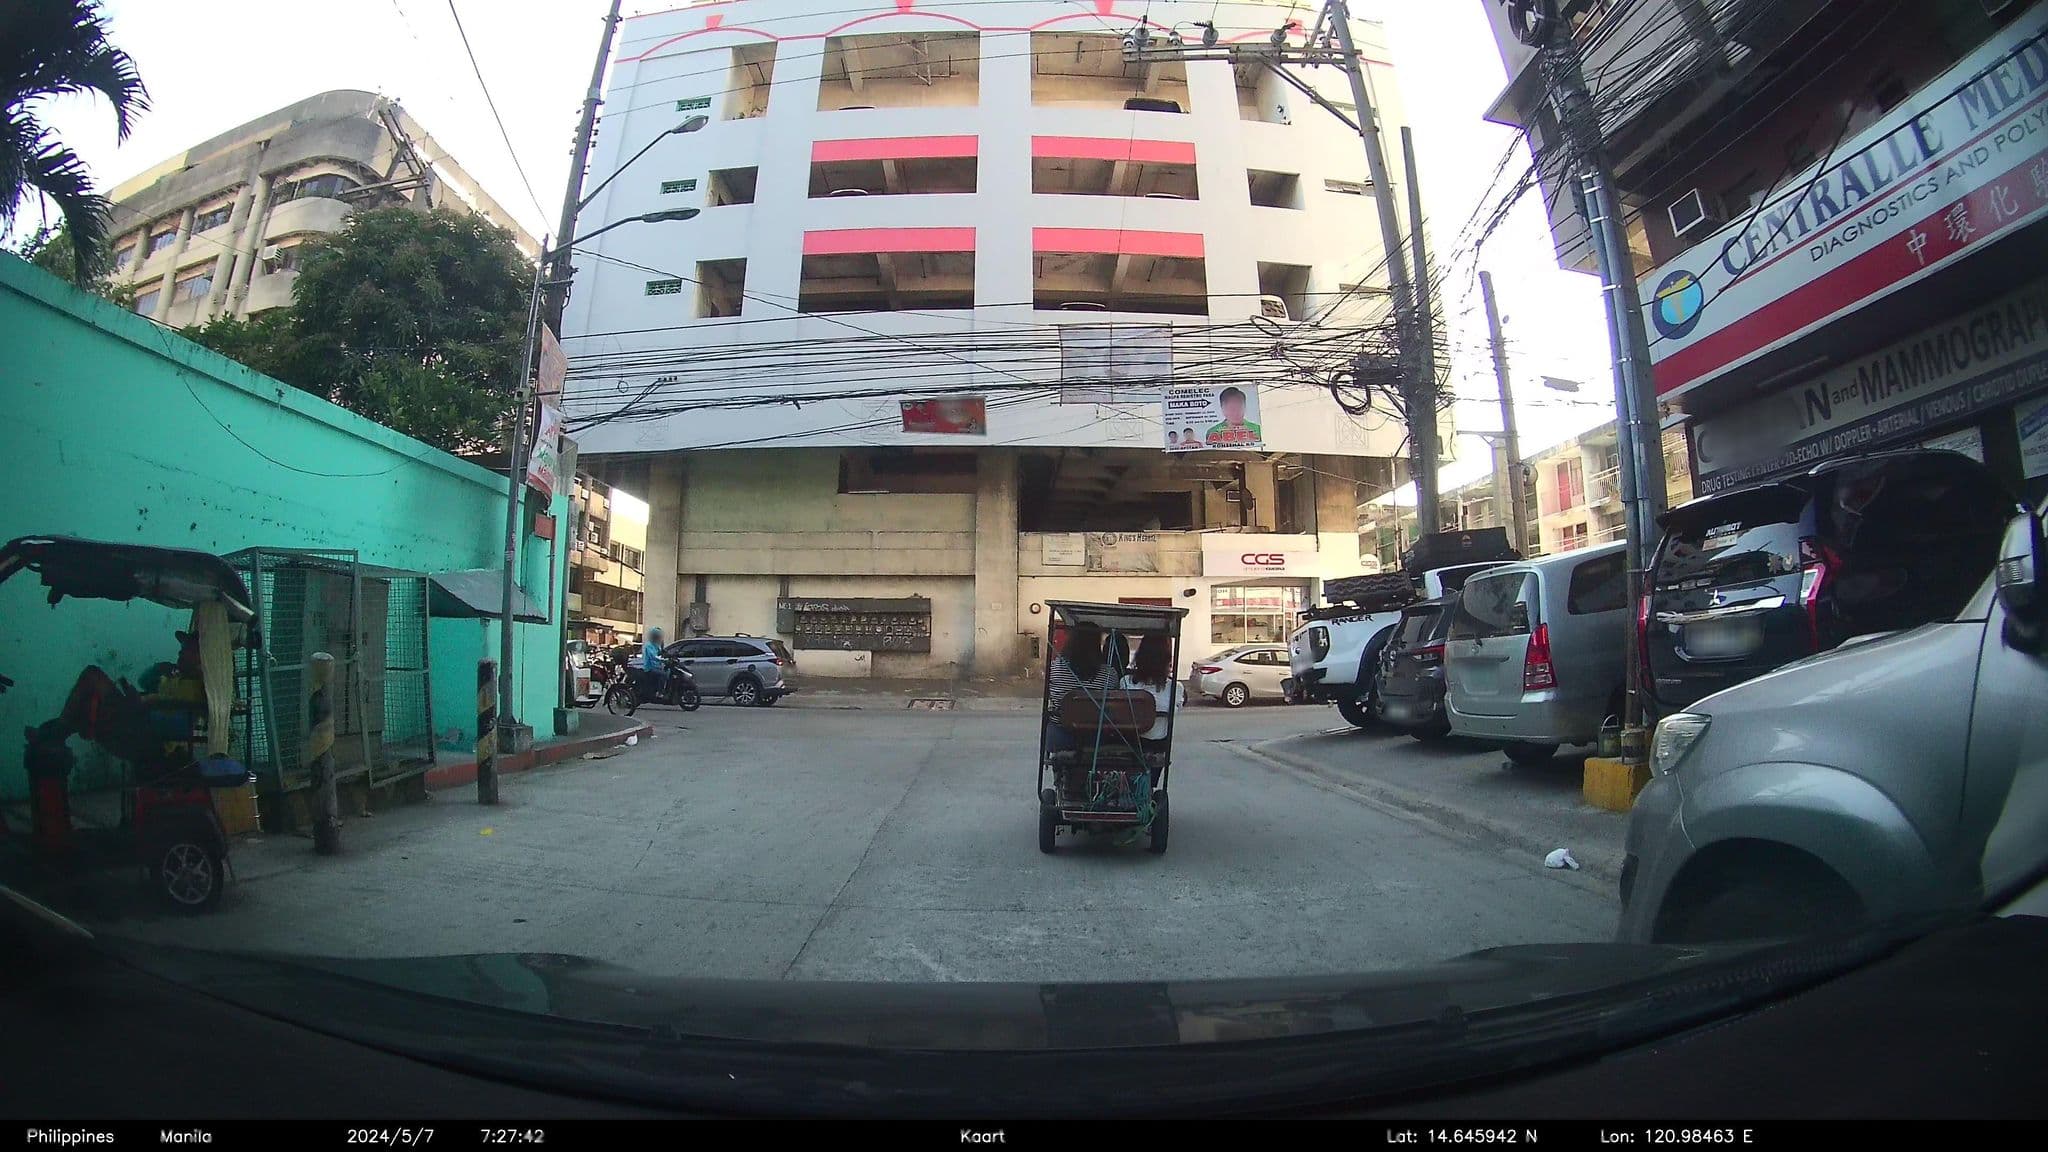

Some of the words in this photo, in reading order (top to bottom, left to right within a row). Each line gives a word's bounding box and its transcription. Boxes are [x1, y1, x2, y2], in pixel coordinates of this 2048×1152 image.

[1721, 112, 1945, 276] CENTRALLE
[1953, 26, 2048, 132] MED
[1810, 176, 1939, 262] DIAGNOSTICS
[1945, 146, 1989, 185] AND
[1994, 105, 2048, 152] POLY
[1832, 382, 1858, 405] and
[1859, 290, 2048, 405] MAMMOGRAP
[1701, 475, 1721, 494] DRUG
[1834, 424, 1872, 451] DOPPLER
[1877, 407, 1920, 435] ARTERIAL
[1241, 553, 1285, 565] CGS
